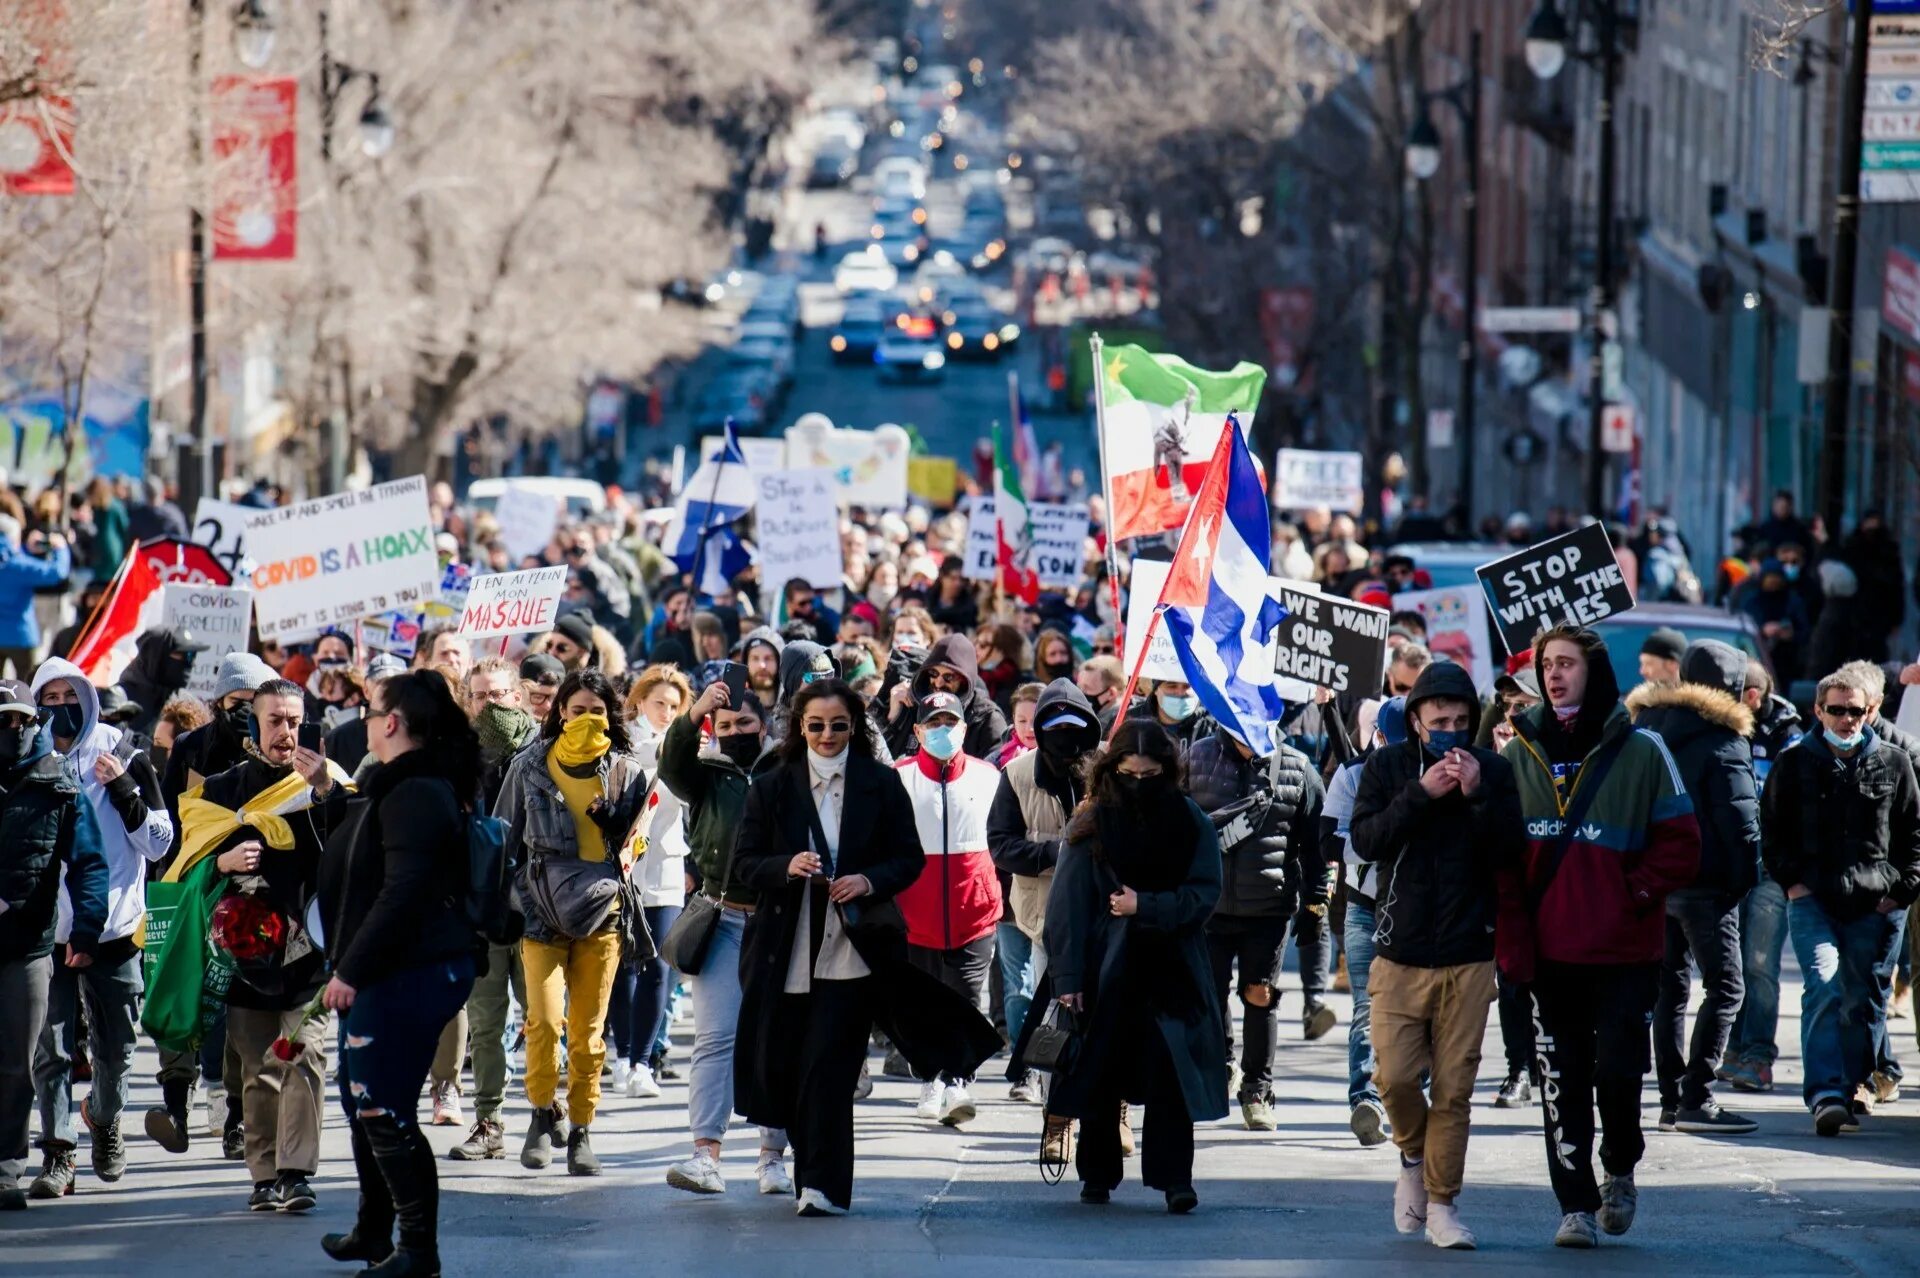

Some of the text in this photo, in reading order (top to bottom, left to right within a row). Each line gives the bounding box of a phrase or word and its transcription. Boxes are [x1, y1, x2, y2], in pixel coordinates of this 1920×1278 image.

[252, 526, 431, 591] COVID IS A HOAX
[1038, 555, 1076, 576] SON
[1503, 546, 1582, 598] STOP
[494, 588, 529, 600] MON
[1573, 563, 1623, 595] THE
[372, 596, 387, 609] TO
[459, 596, 553, 633] MASQUE
[1284, 591, 1389, 640] WE WANT
[1292, 623, 1334, 657] OUR
